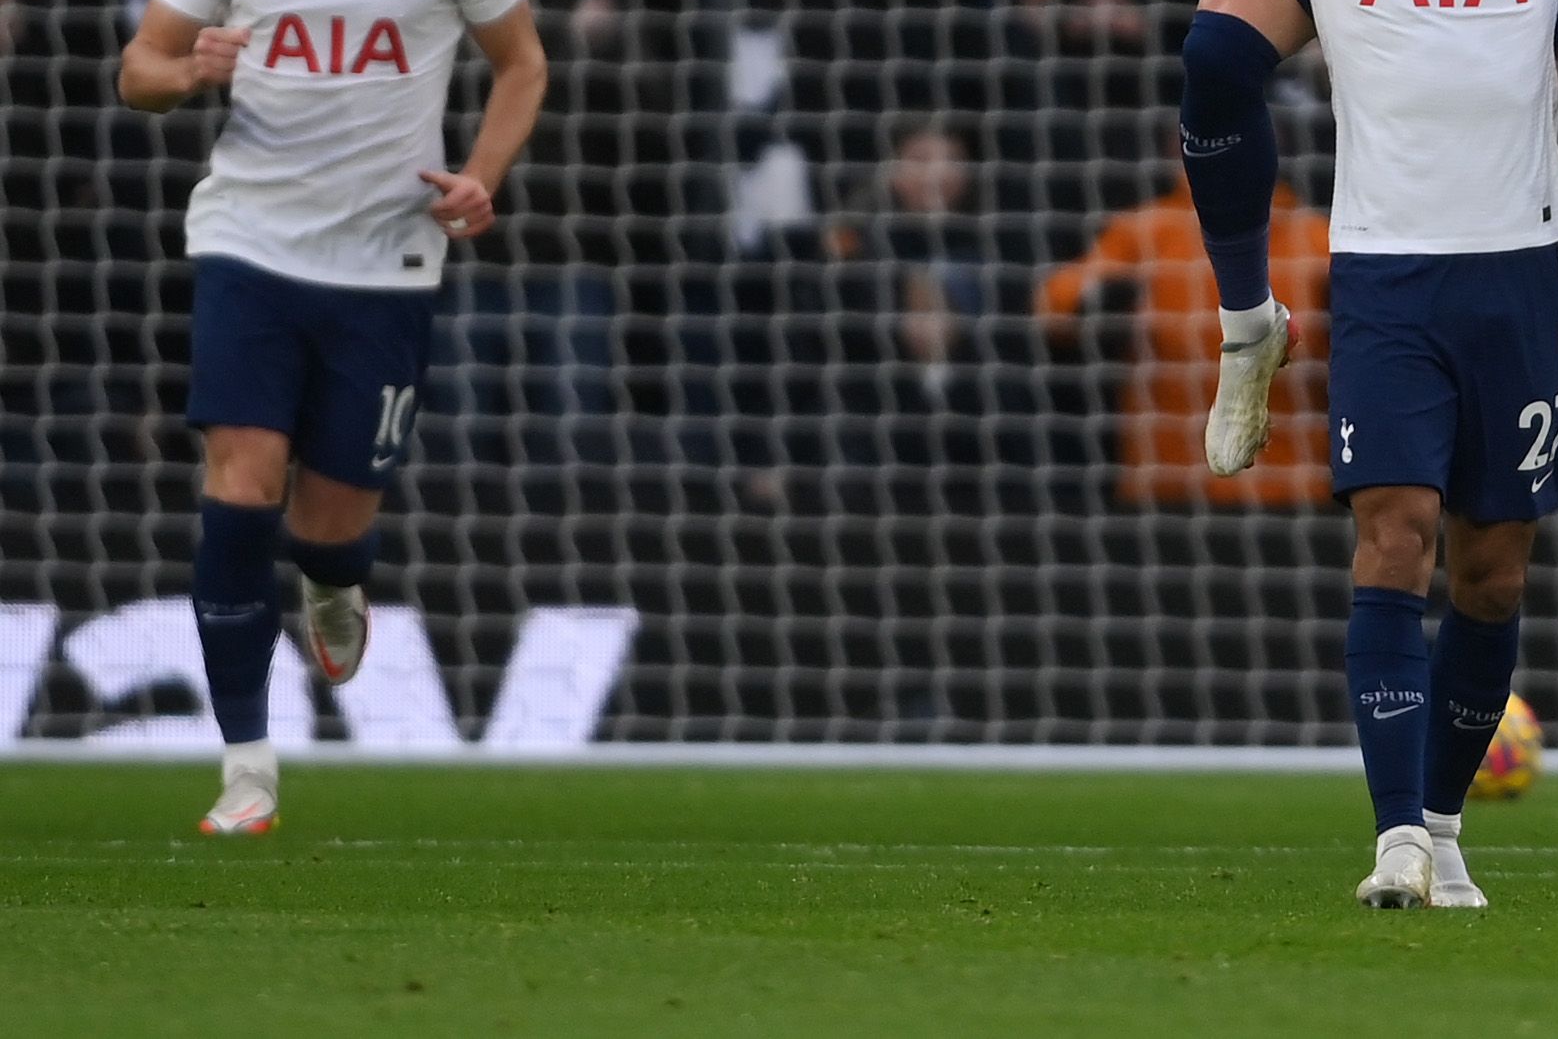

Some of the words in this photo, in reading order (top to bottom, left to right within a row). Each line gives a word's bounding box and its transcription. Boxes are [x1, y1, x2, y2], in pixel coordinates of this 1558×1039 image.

[265, 13, 410, 75] AIA
[1360, 690, 1424, 705] SPURS
[1449, 700, 1505, 722] SPUR
